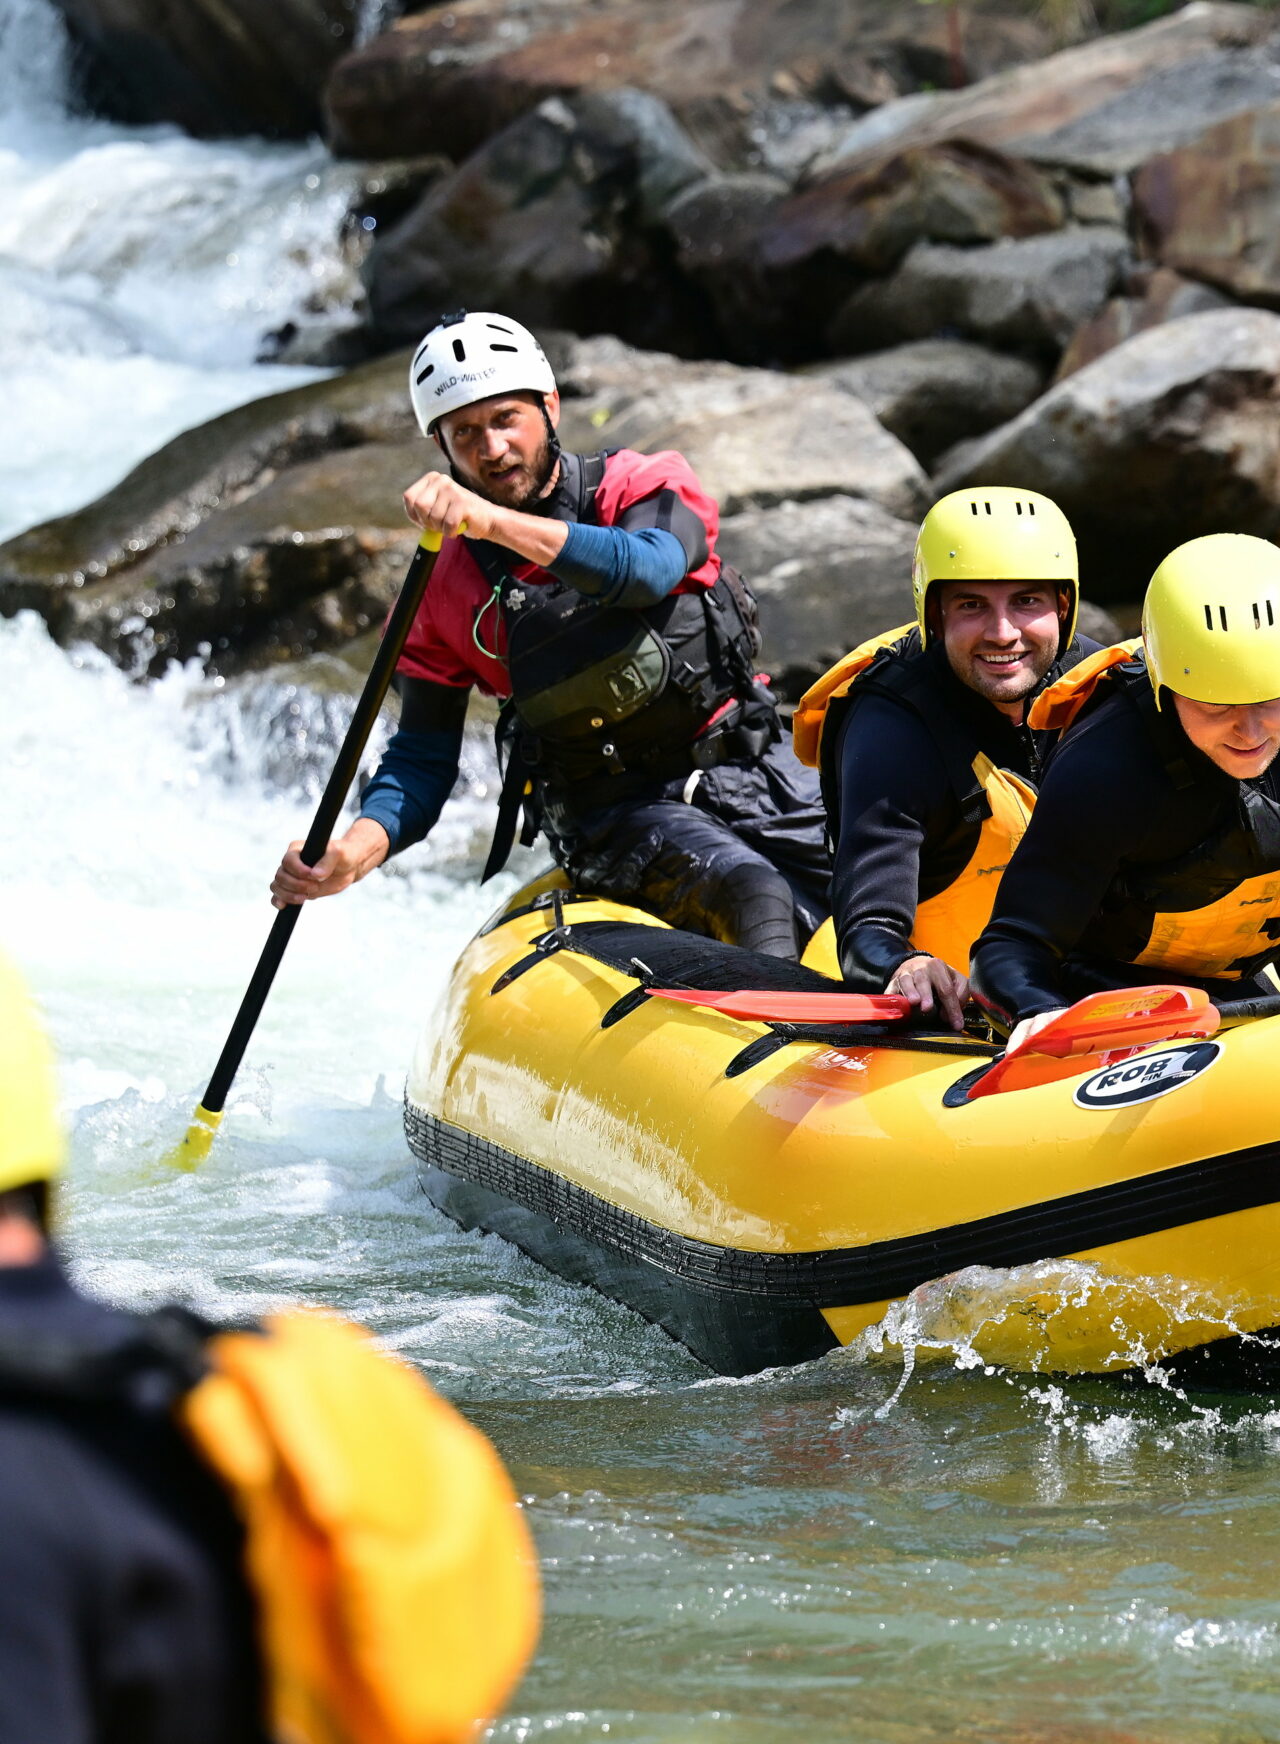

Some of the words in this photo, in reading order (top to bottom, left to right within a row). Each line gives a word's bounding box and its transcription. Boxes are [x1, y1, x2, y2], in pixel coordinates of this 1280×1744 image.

[434, 367, 496, 397] WILD-WATER
[1096, 1058, 1173, 1091] ROB
[1140, 1072, 1163, 1083] FIN
